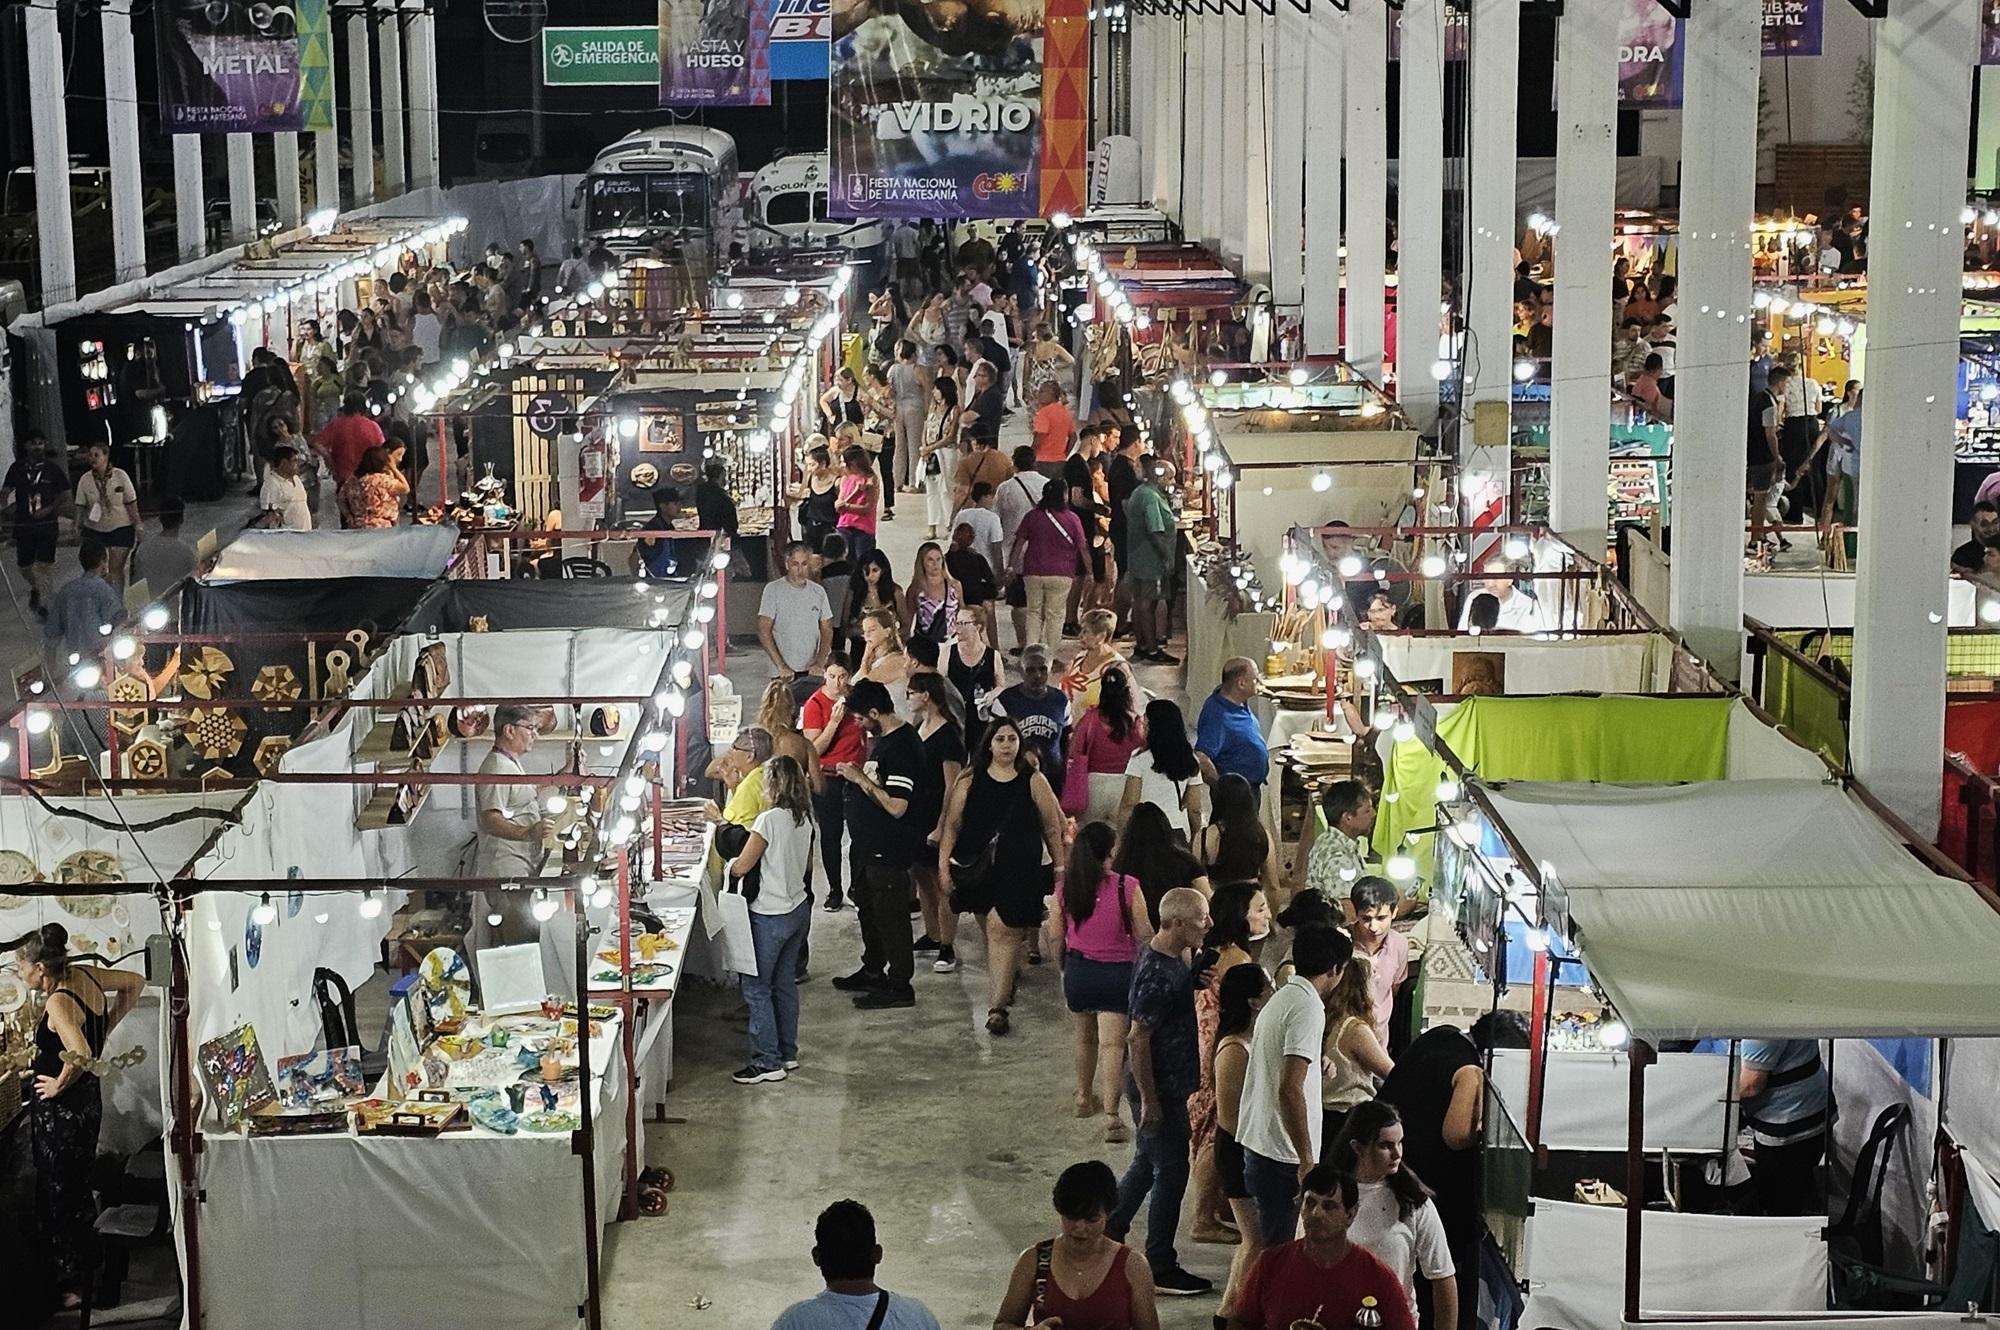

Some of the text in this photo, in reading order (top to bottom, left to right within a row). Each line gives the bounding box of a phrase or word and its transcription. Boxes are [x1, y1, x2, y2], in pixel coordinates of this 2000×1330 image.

[582, 41, 644, 53] SALIDA DE
[690, 40, 745, 53] ASTA Y
[575, 52, 659, 64] EMERGENCIA
[686, 54, 745, 68] HUESO
[203, 54, 290, 75] METAL
[893, 102, 1031, 132] VIDRIO
[773, 182, 808, 192] COLON
[869, 177, 957, 189] FIESTA NACIONAL
[869, 189, 881, 200] DE
[885, 189, 898, 200] LA
